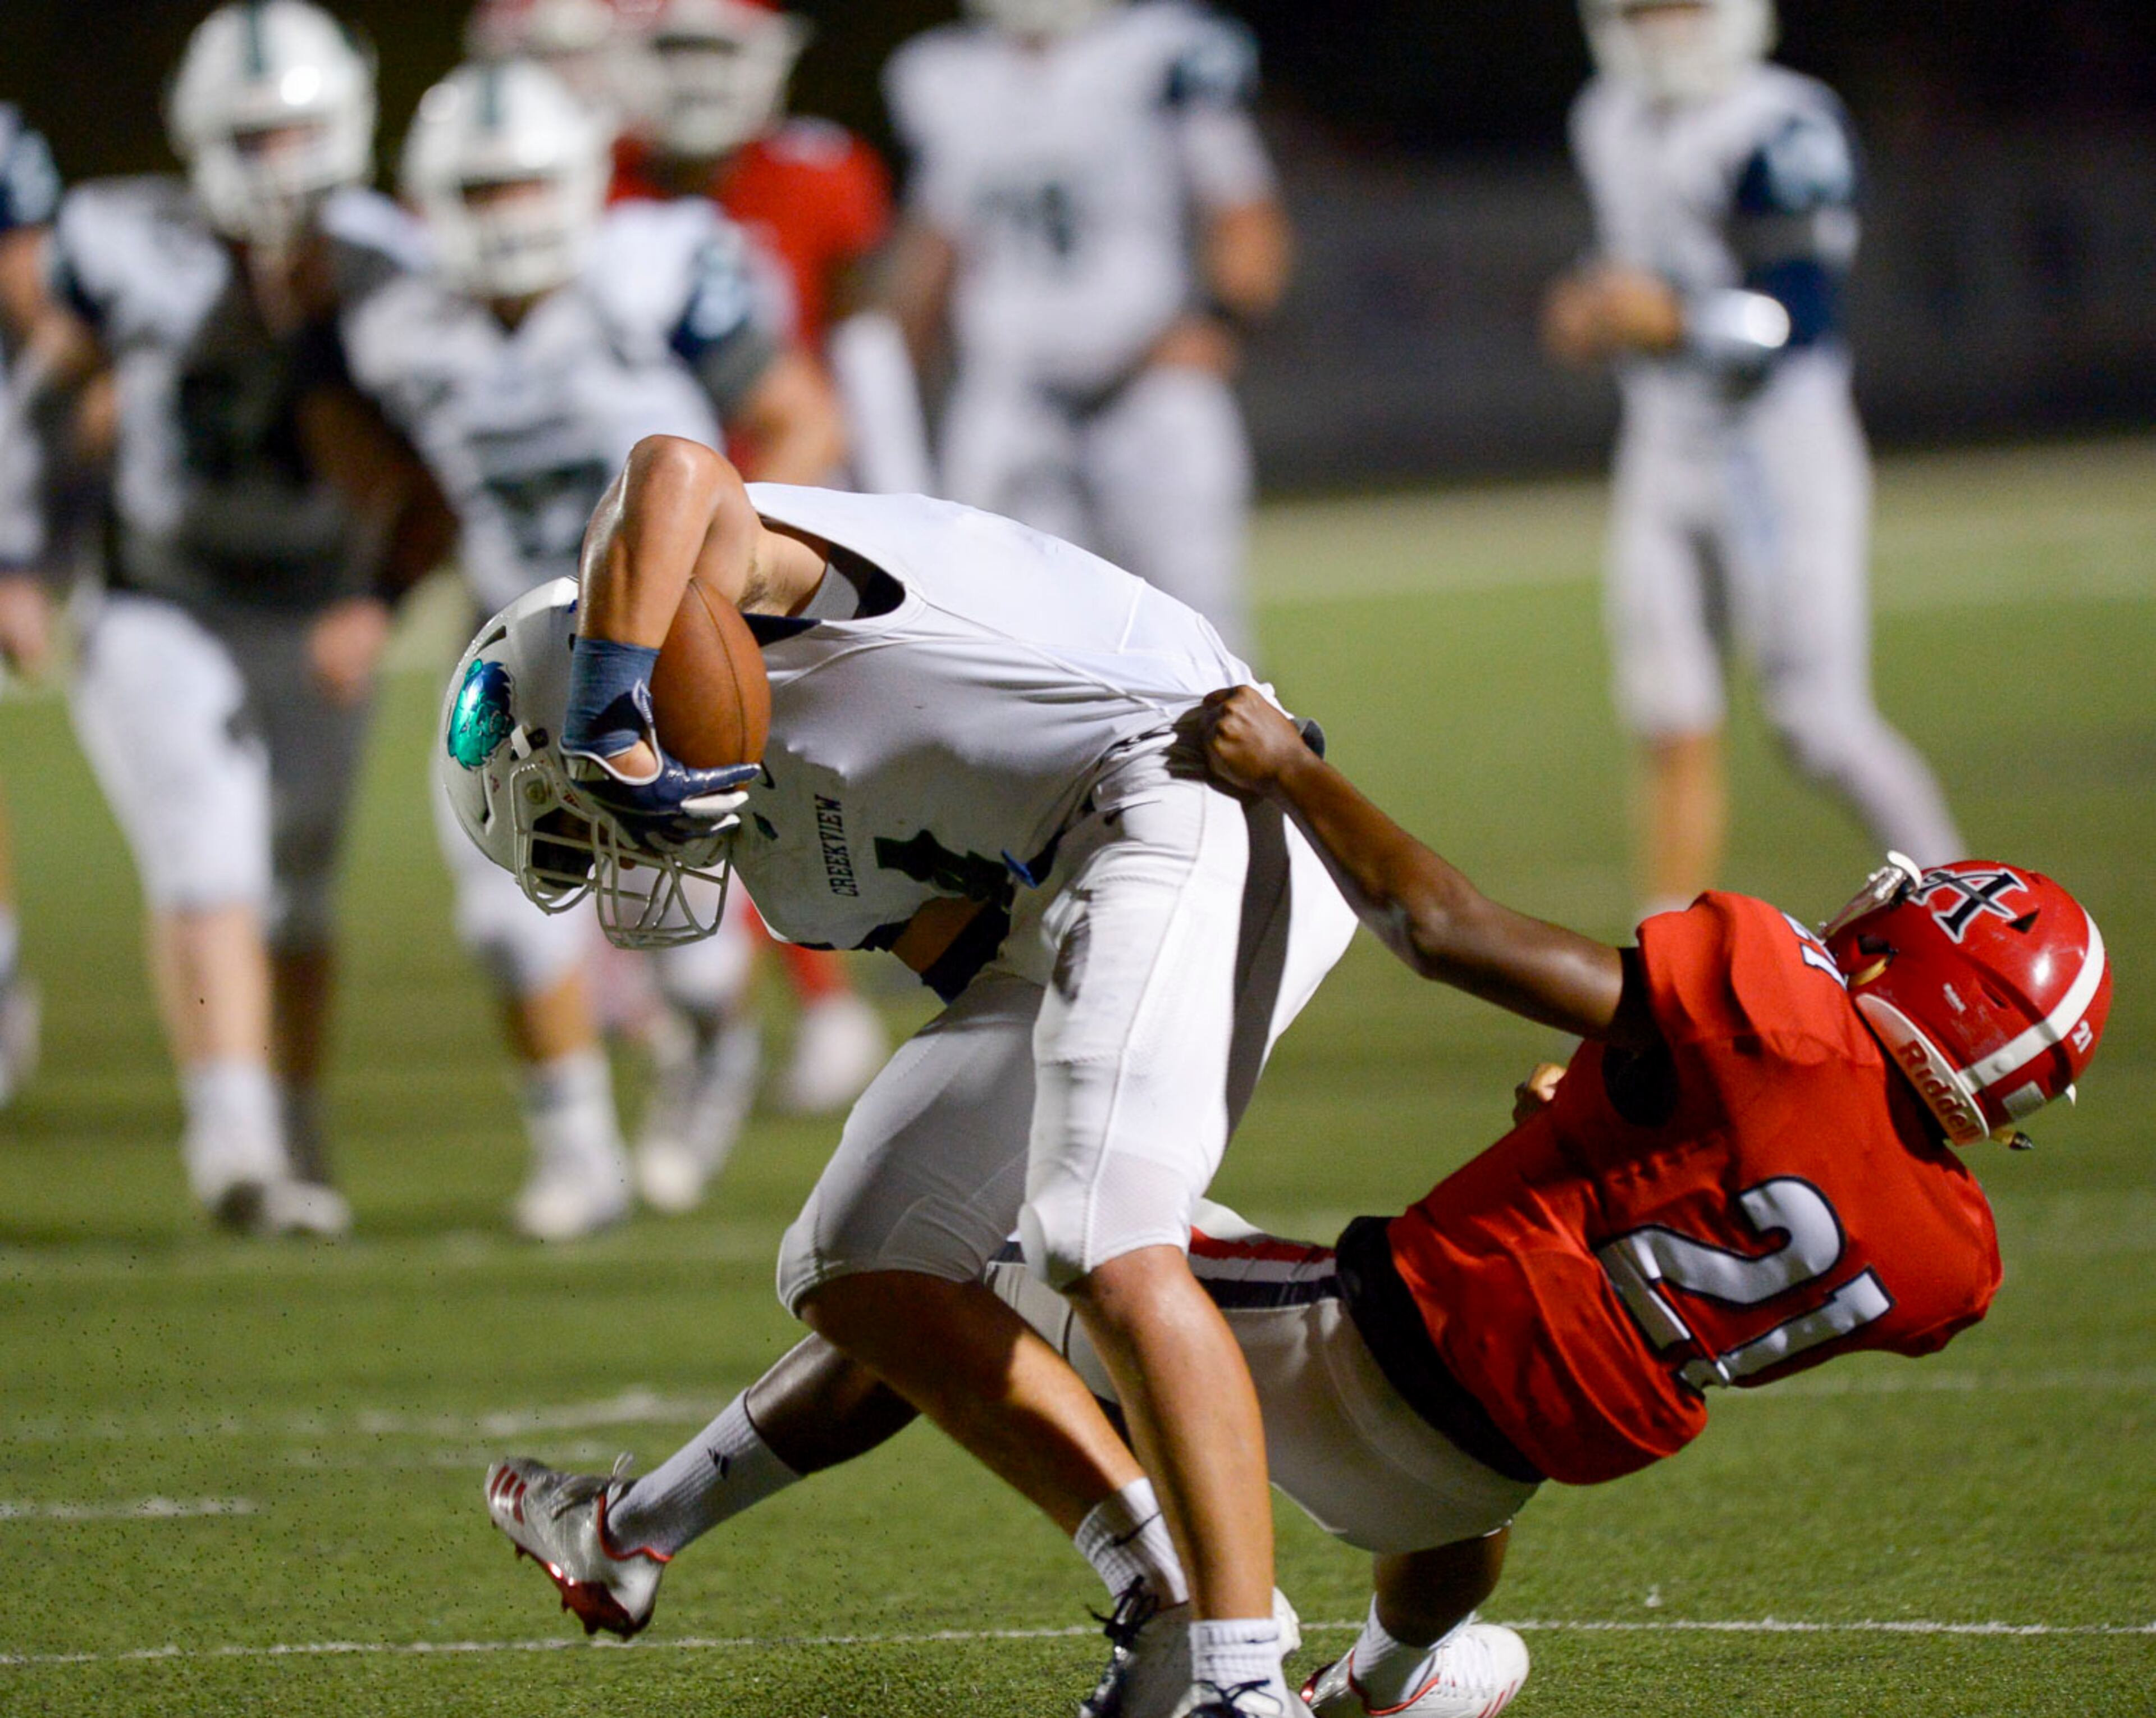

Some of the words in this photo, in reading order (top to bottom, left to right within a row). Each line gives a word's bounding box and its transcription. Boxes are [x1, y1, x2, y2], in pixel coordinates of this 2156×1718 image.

[814, 793, 859, 897] CREEKVIEW
[2072, 1020, 2094, 1054] 21
[1595, 1175, 1895, 1389] 21
